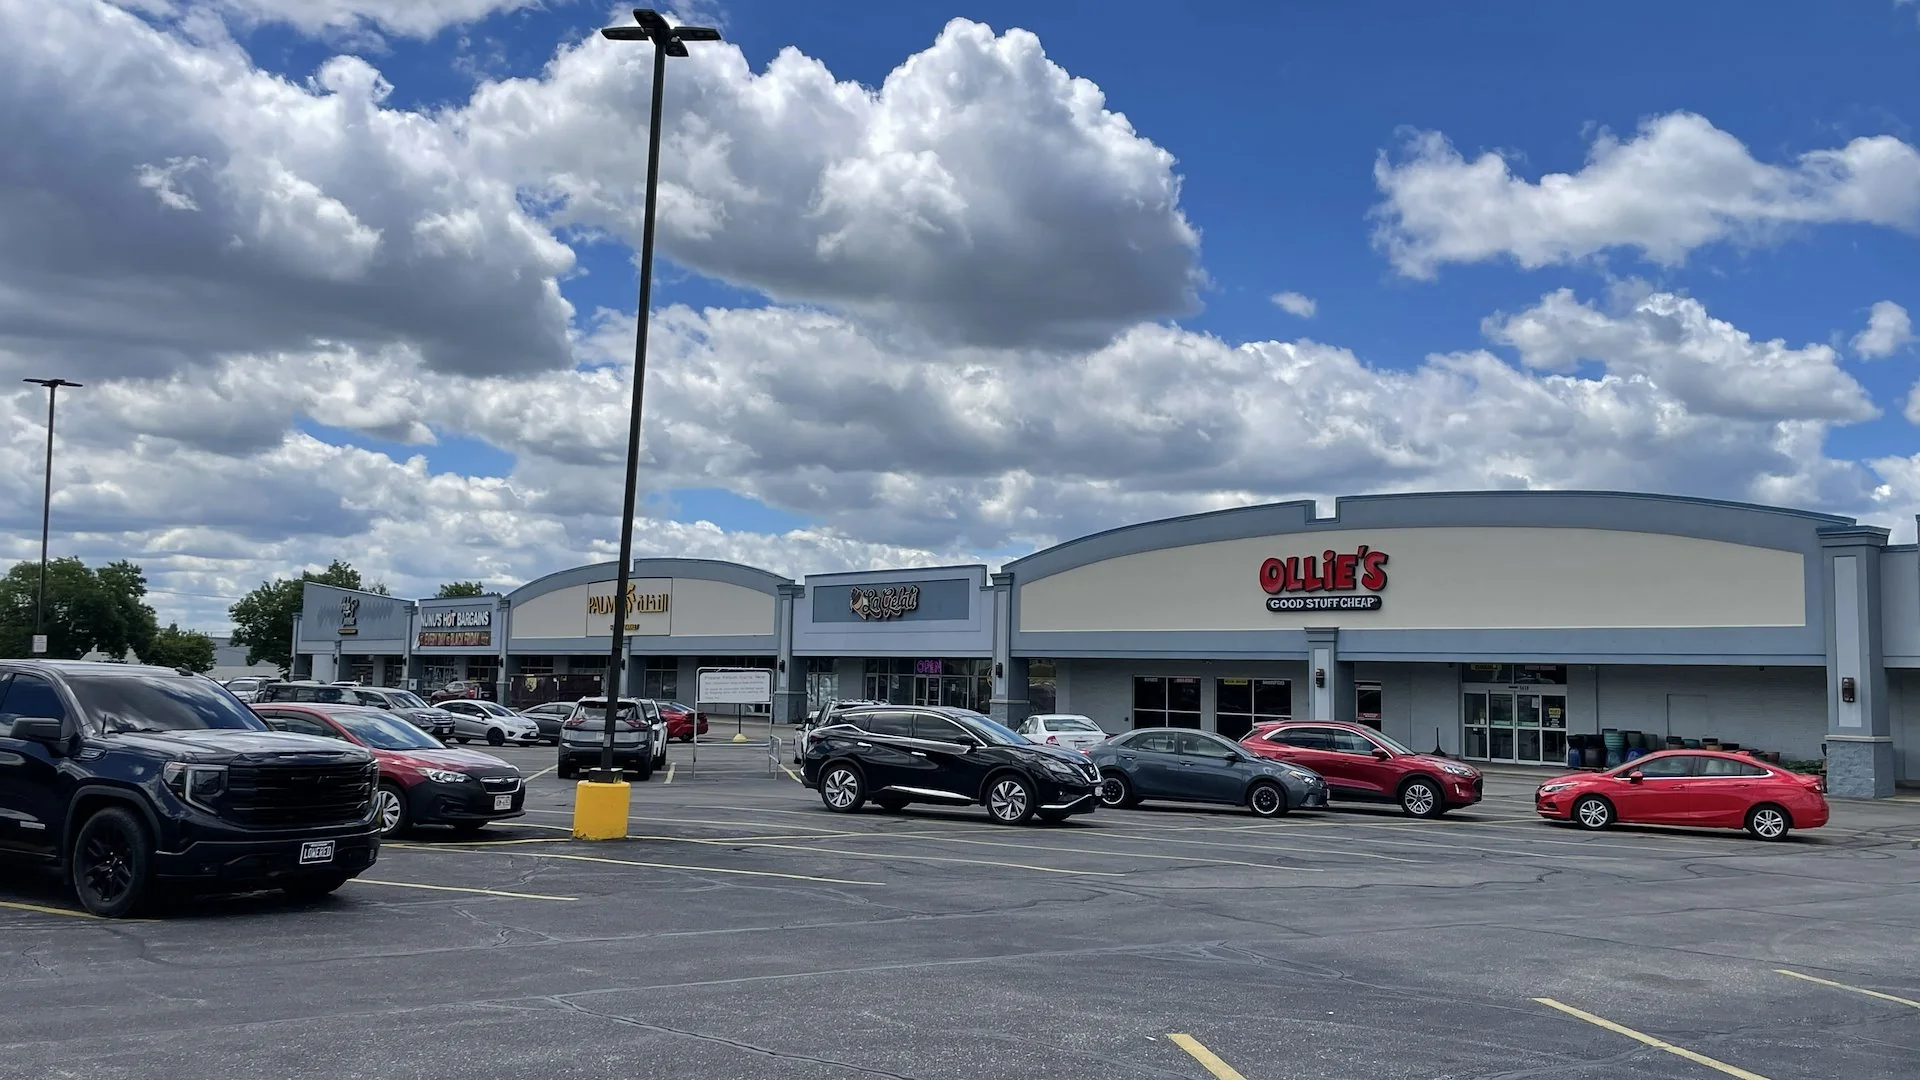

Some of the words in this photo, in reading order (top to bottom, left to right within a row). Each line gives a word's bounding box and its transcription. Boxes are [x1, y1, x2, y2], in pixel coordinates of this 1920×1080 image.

[1306, 598, 1339, 609] STUFF
[442, 610, 456, 627] HOT
[457, 610, 489, 626] BARGAINS
[916, 660, 941, 673] OPEN
[303, 846, 331, 859] LOWERED
